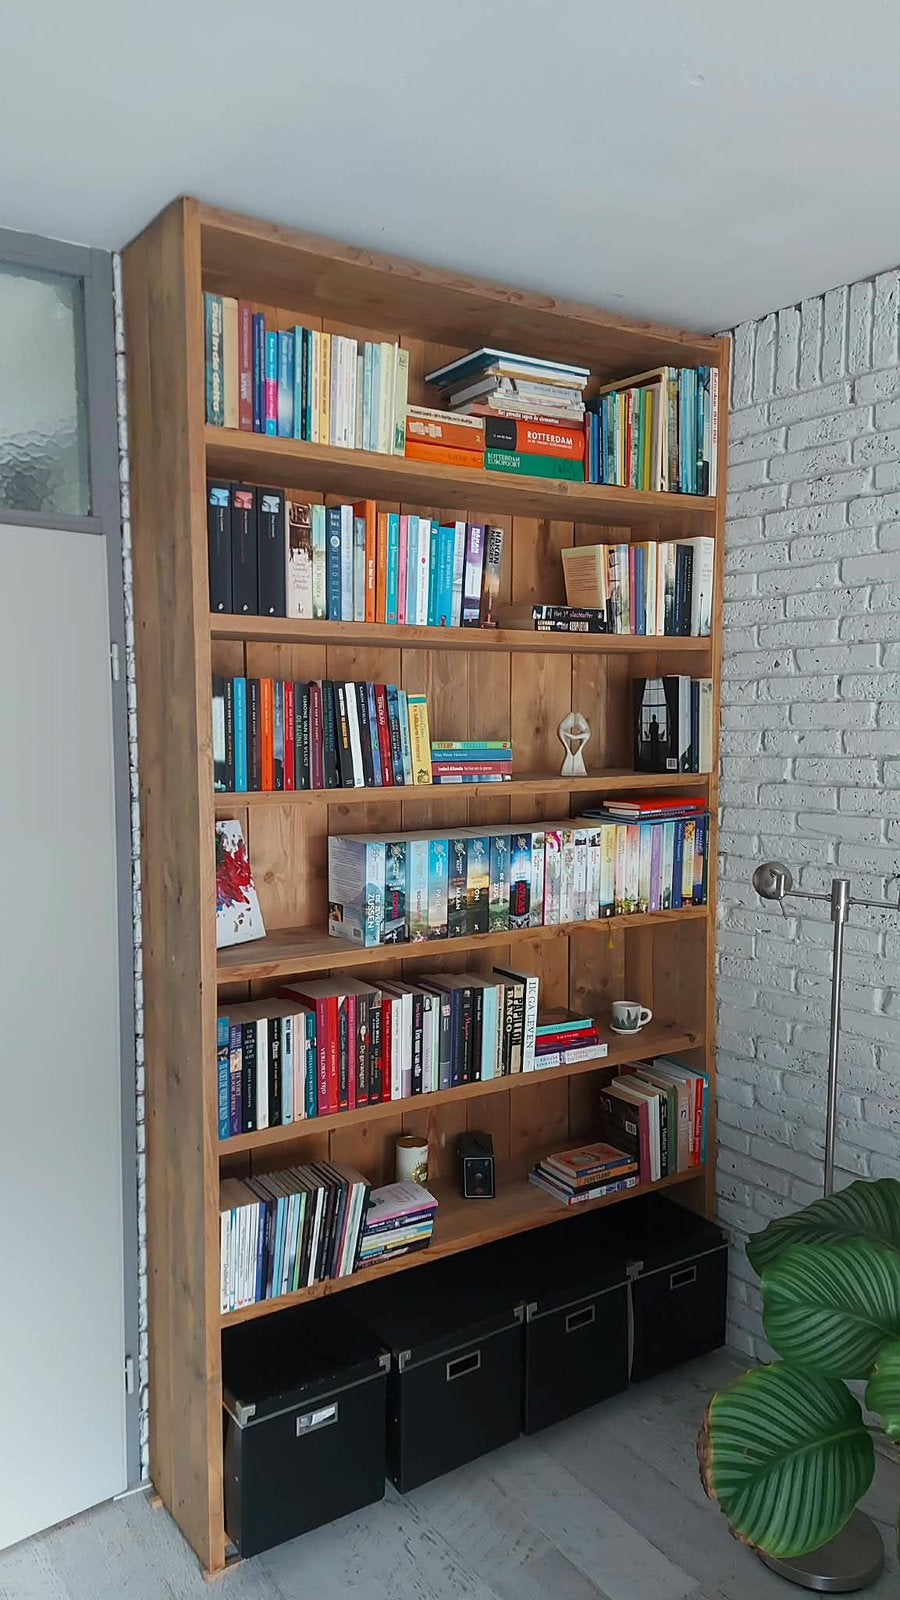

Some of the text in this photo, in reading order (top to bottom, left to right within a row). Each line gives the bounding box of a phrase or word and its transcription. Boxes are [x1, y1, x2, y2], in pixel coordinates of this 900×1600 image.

[527, 430, 573, 446] ROTTERDAM
[506, 990, 514, 1032] BANCO
[511, 998, 523, 1046] PAPILLON
[526, 982, 536, 1050] IK GA LEVEN
[360, 1045, 365, 1053] De
